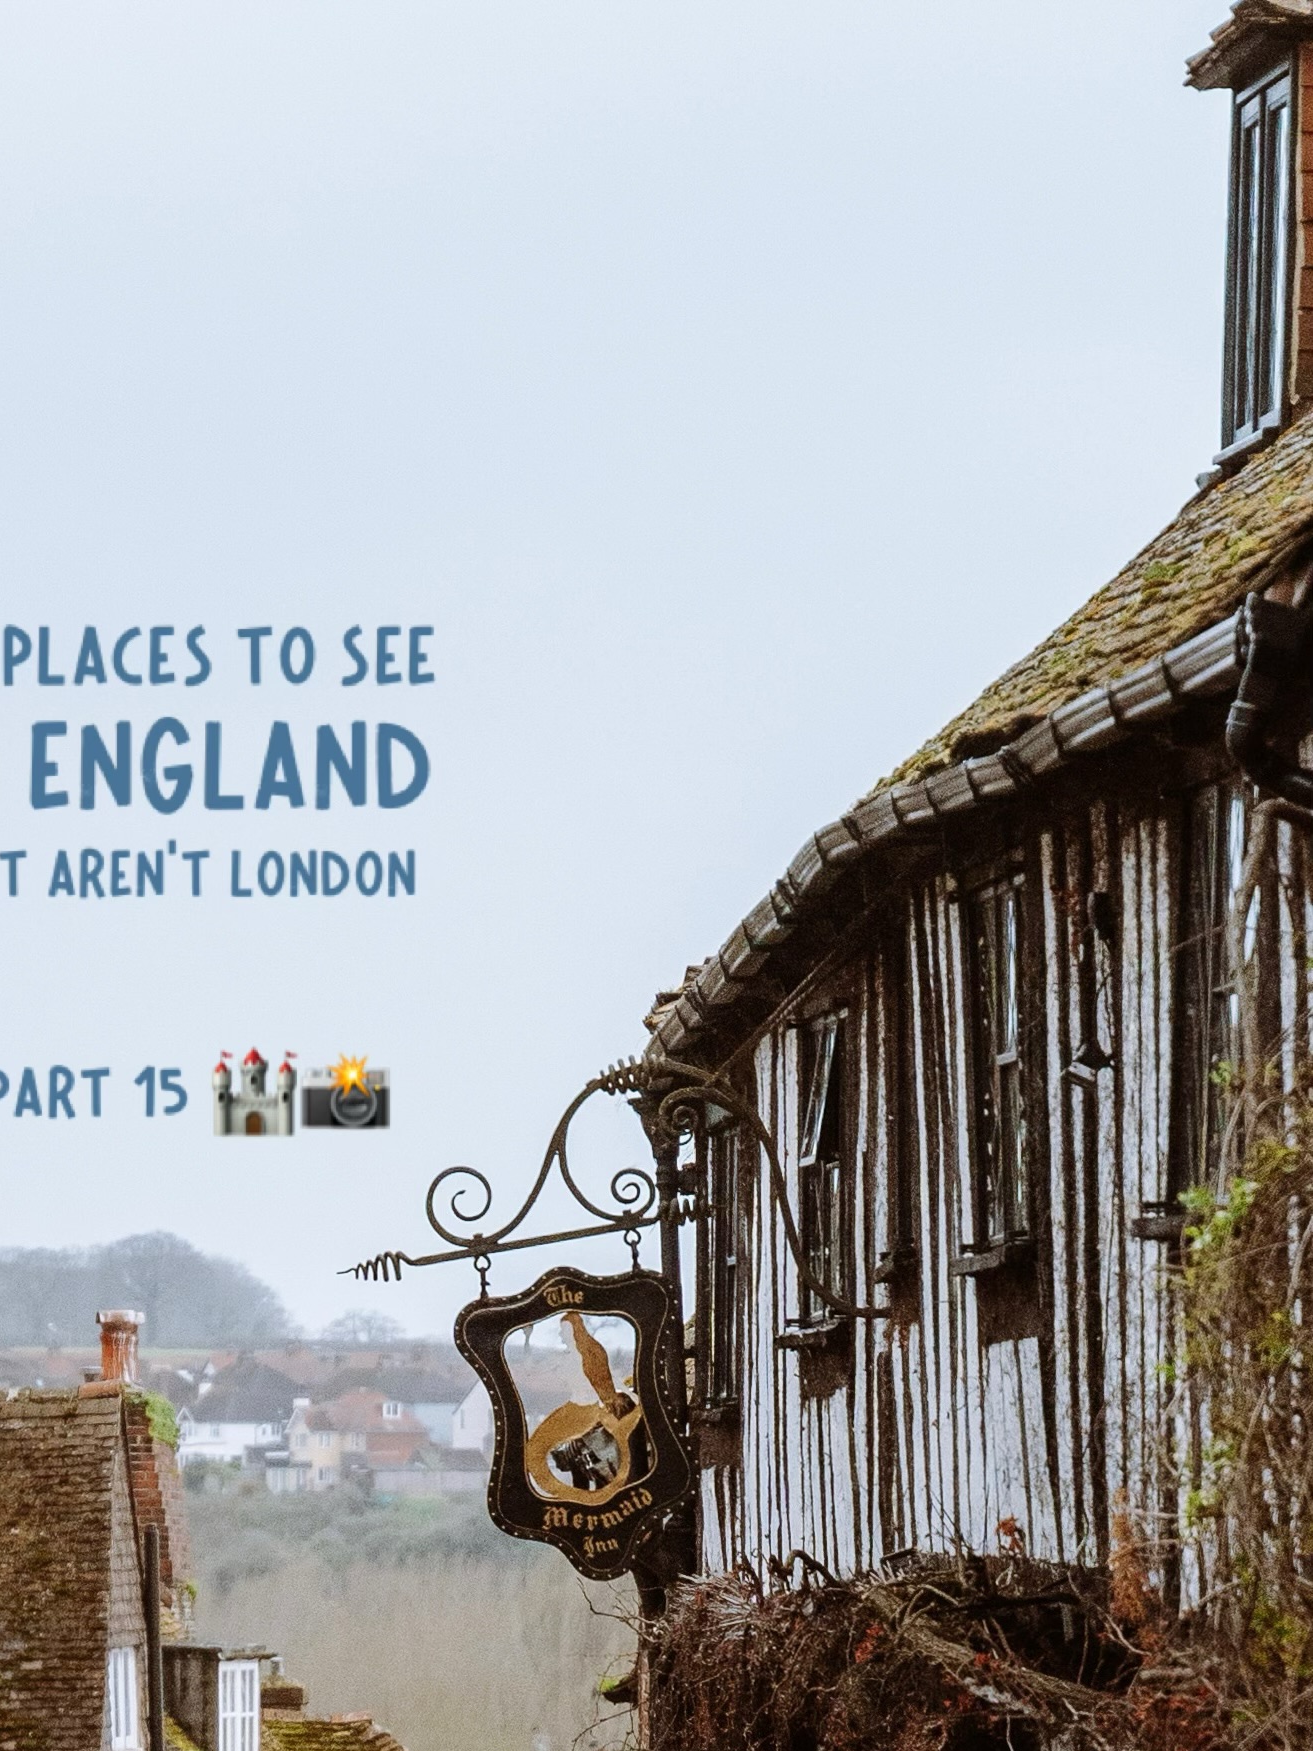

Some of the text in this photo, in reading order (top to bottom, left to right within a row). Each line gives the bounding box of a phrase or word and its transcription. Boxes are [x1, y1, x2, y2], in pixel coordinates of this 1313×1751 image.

[543, 1284, 584, 1307] The
[542, 1488, 653, 1531] Mermaid
[583, 1536, 619, 1558] Inn
